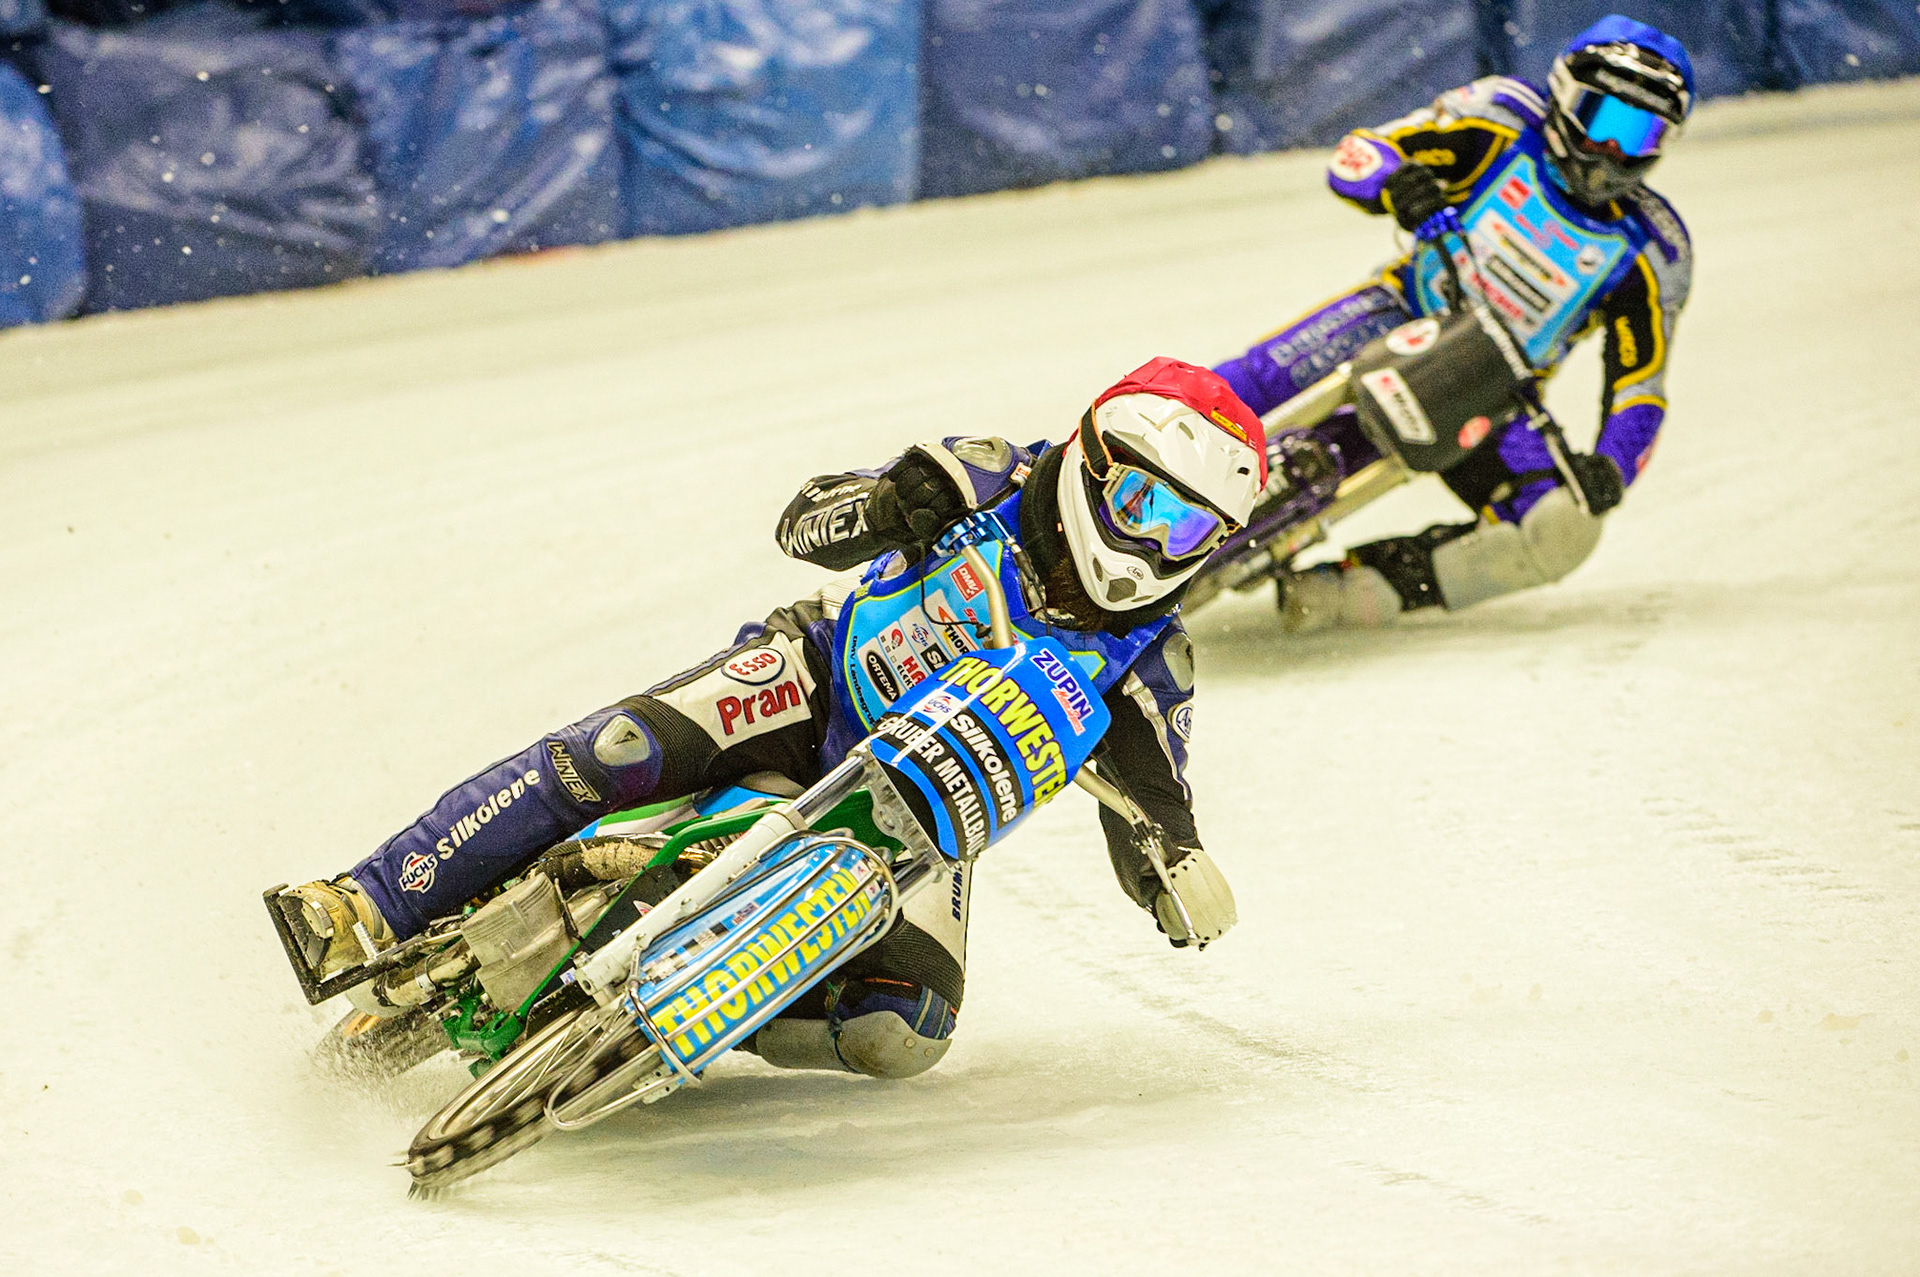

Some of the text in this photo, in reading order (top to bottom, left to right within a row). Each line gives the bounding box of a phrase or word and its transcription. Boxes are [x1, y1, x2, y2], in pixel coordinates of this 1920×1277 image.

[716, 680, 801, 736] Pran
[868, 654, 898, 700] ORTEMA
[1032, 650, 1092, 720] ZUPIN
[877, 716, 987, 856] GRUBER METALLBAU
[950, 713, 1018, 822] Silkolene
[436, 768, 541, 861] Silkolene
[401, 855, 437, 889] FUCHS
